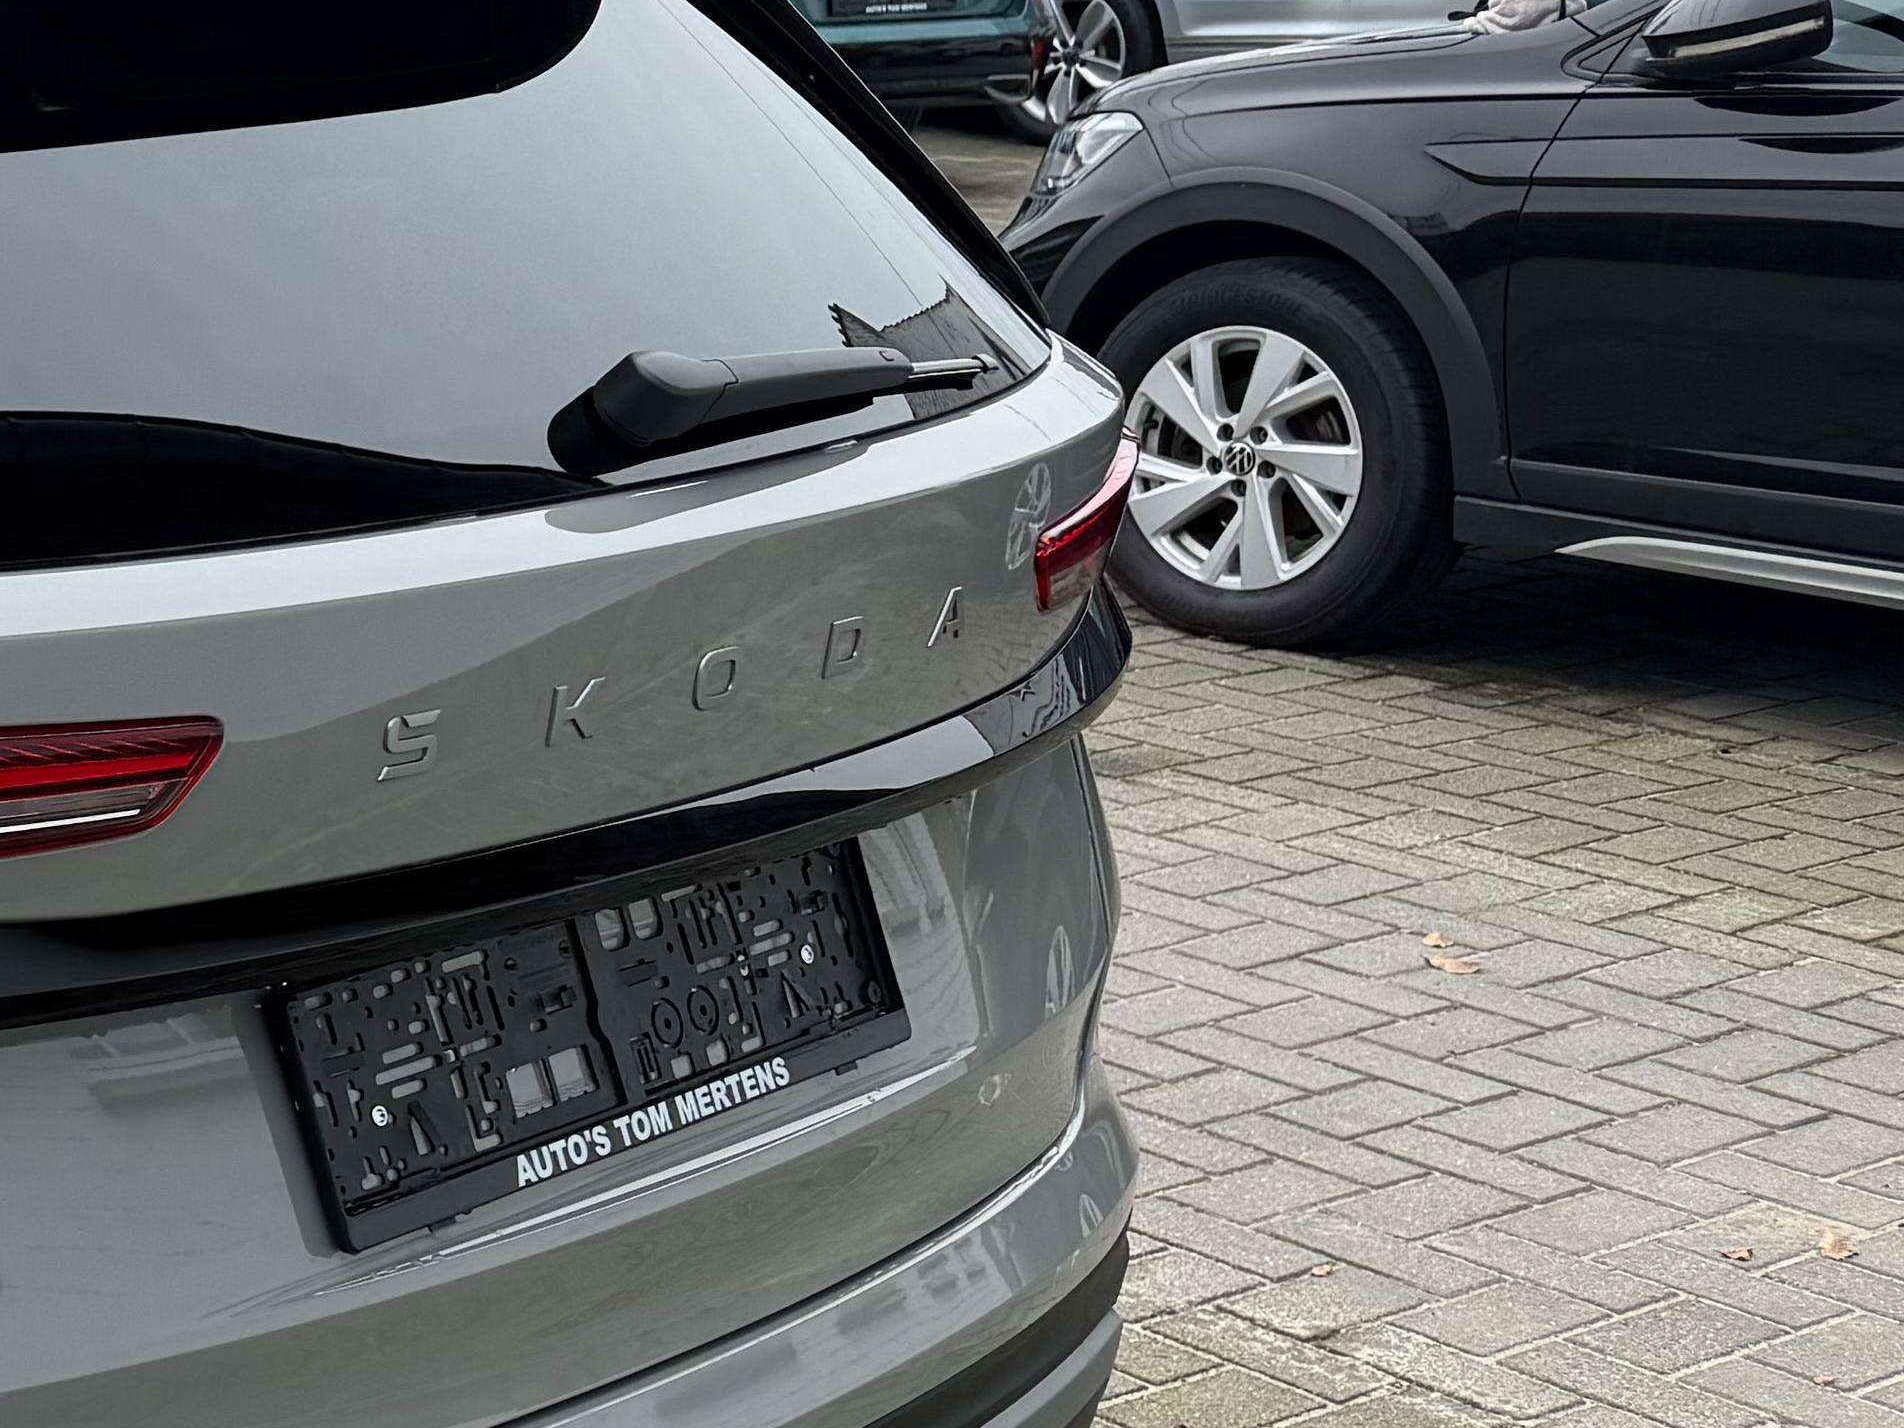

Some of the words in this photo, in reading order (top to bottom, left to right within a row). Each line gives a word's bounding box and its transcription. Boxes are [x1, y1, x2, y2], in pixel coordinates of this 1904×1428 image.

[516, 1129, 611, 1187] AUTO'S
[613, 1101, 673, 1147] TOM
[676, 1057, 790, 1124] MERTENS
